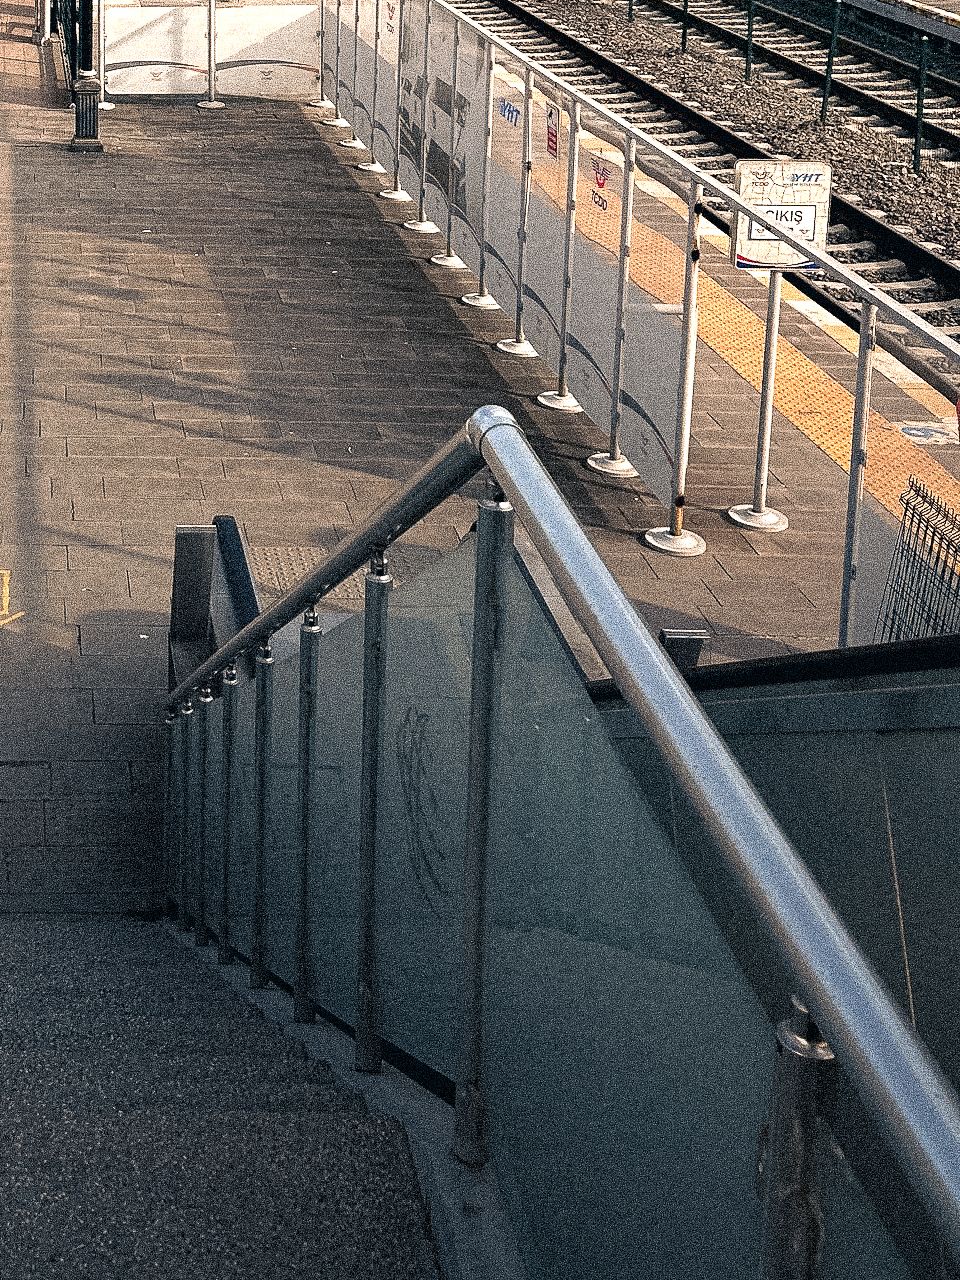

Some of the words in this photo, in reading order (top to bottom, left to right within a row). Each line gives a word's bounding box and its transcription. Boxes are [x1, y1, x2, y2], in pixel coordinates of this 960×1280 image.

[792, 173, 823, 183] YHT
[591, 189, 608, 211] TCDD
[765, 210, 803, 225] IKIŞ
